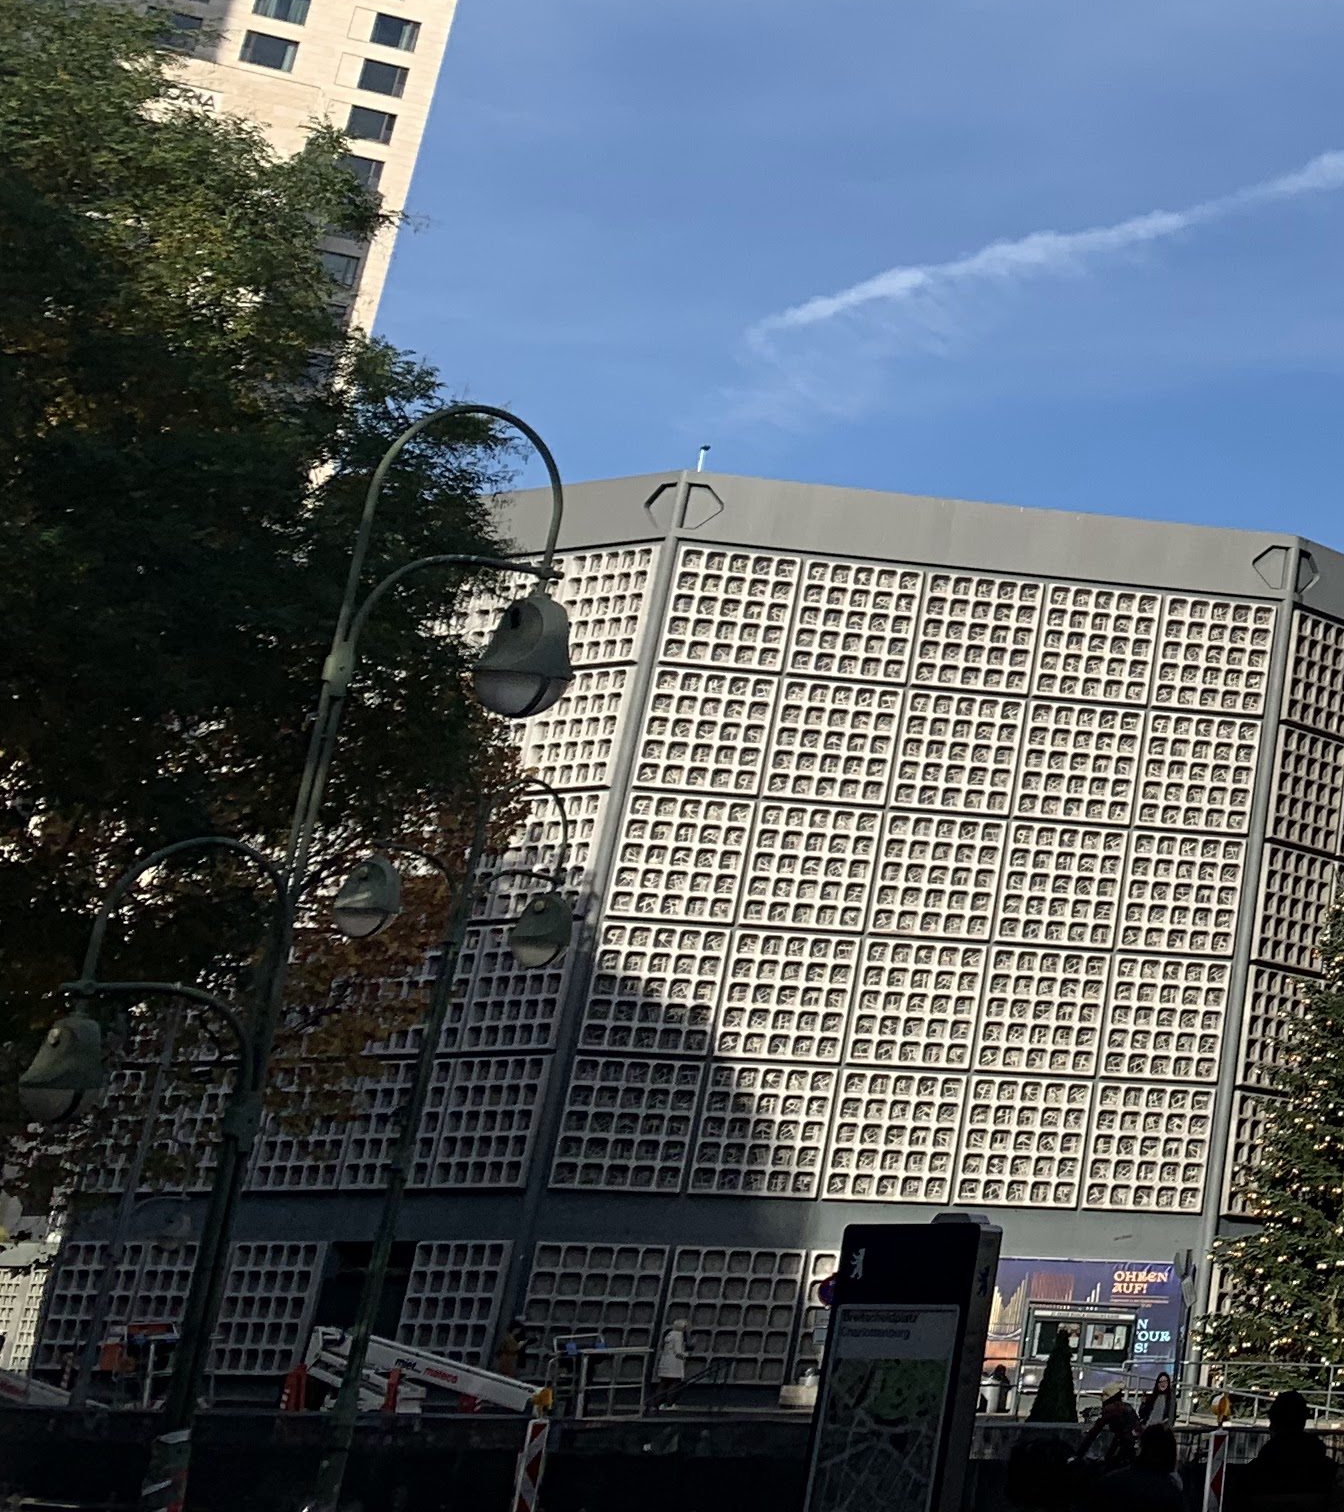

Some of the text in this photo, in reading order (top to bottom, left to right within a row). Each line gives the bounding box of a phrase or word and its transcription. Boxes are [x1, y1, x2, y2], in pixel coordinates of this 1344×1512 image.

[1113, 1270, 1169, 1283] OHREN
[1111, 1282, 1148, 1294] AUF!
[1137, 1329, 1171, 1342] OUR
